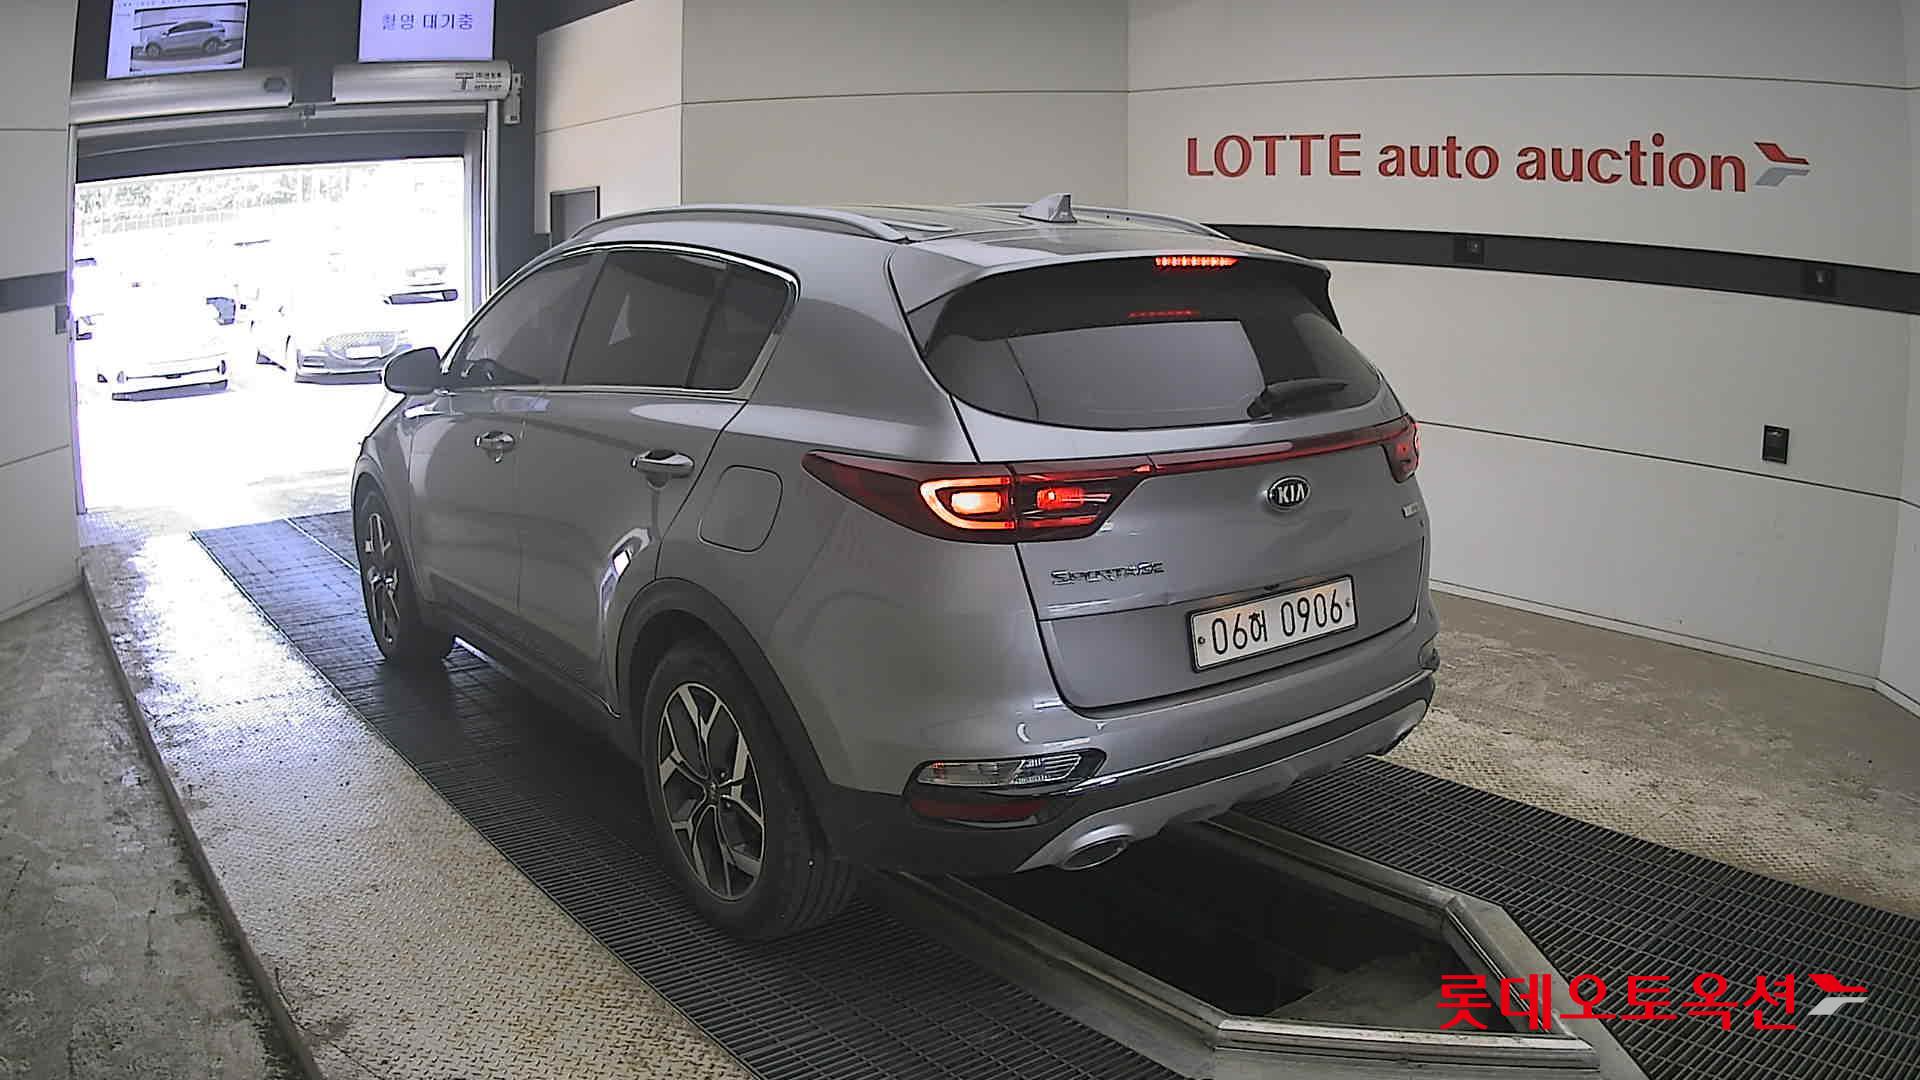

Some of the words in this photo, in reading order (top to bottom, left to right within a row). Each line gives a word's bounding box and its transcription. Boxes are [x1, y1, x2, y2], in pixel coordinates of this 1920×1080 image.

[423, 14, 473, 30] 대기중
[1186, 133, 1362, 177] LOTTE
[1379, 135, 1500, 179] auto
[1516, 132, 1747, 193] auction
[1277, 484, 1305, 505] KIA
[1211, 611, 1267, 656] 06허
[1281, 588, 1344, 638] 0906
